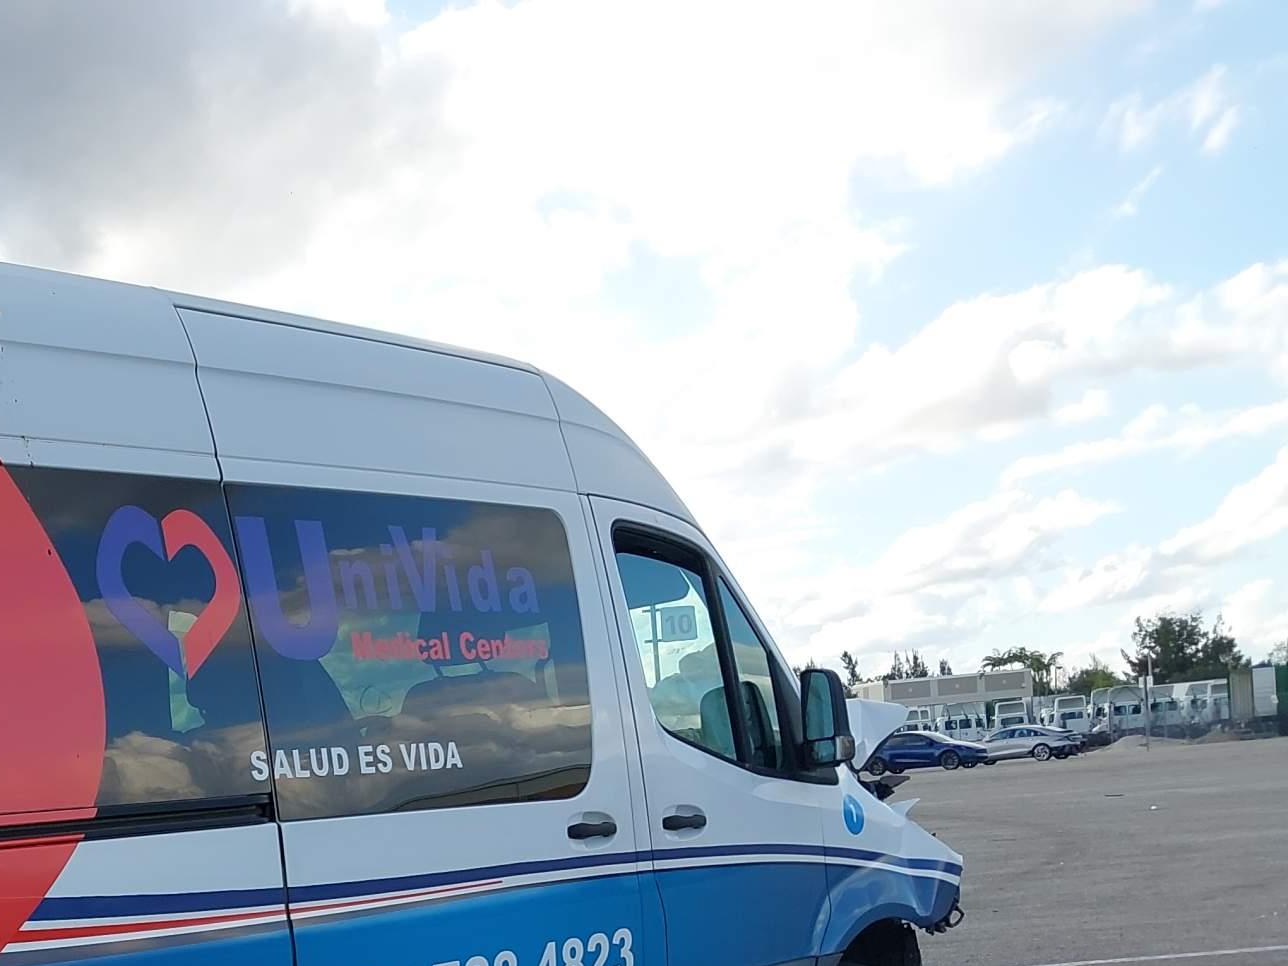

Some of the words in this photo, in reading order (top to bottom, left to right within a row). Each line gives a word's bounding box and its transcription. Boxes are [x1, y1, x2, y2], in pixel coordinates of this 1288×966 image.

[234, 515, 539, 661] UniVida
[665, 614, 692, 635] 10
[250, 745, 349, 781] SALUD
[360, 745, 392, 775] ES
[399, 740, 463, 772] VIDA
